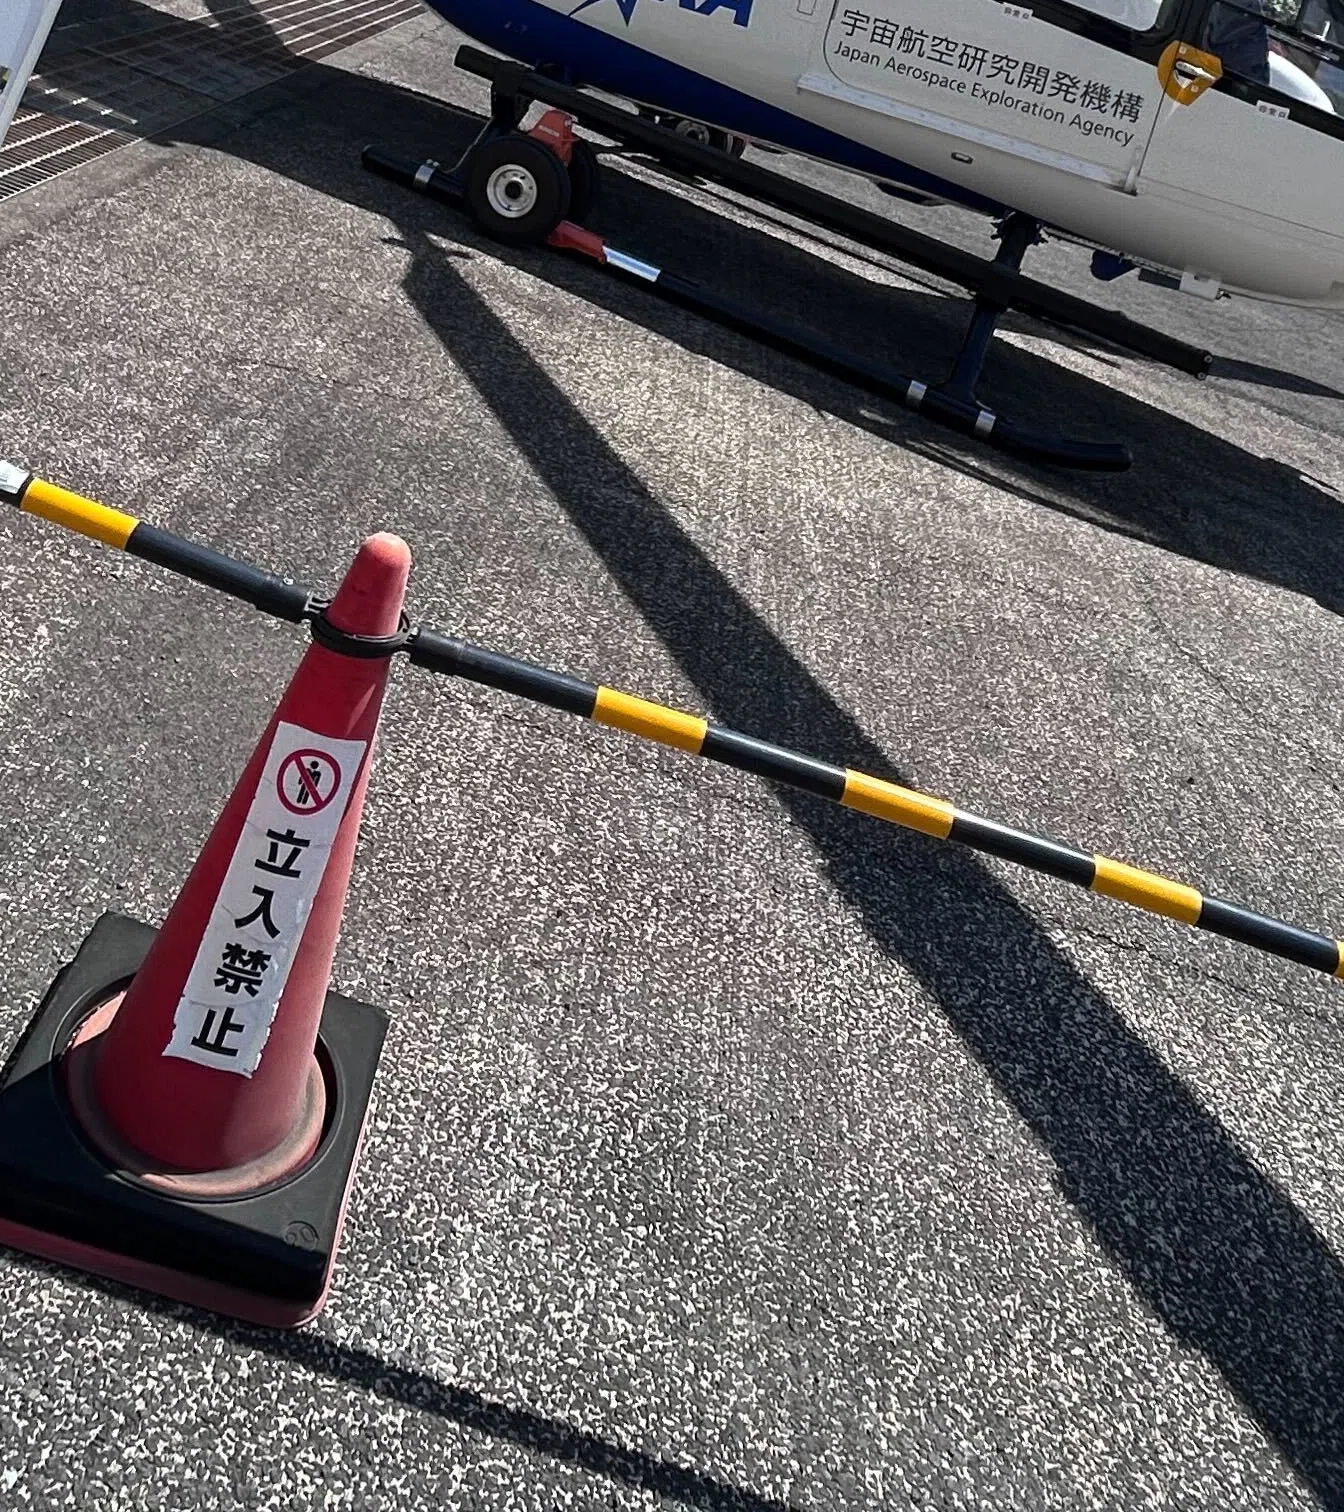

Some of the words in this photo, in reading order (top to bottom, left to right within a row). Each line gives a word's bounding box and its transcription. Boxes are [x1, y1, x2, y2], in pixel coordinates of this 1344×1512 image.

[833, 41, 880, 69] Japan
[885, 58, 967, 95] Aerospace
[971, 82, 1064, 125] Exploration
[1069, 113, 1134, 147] Agency
[840, 8, 1144, 124] 宇宙航空研究開発機構
[192, 829, 311, 1057] 立入禁止
